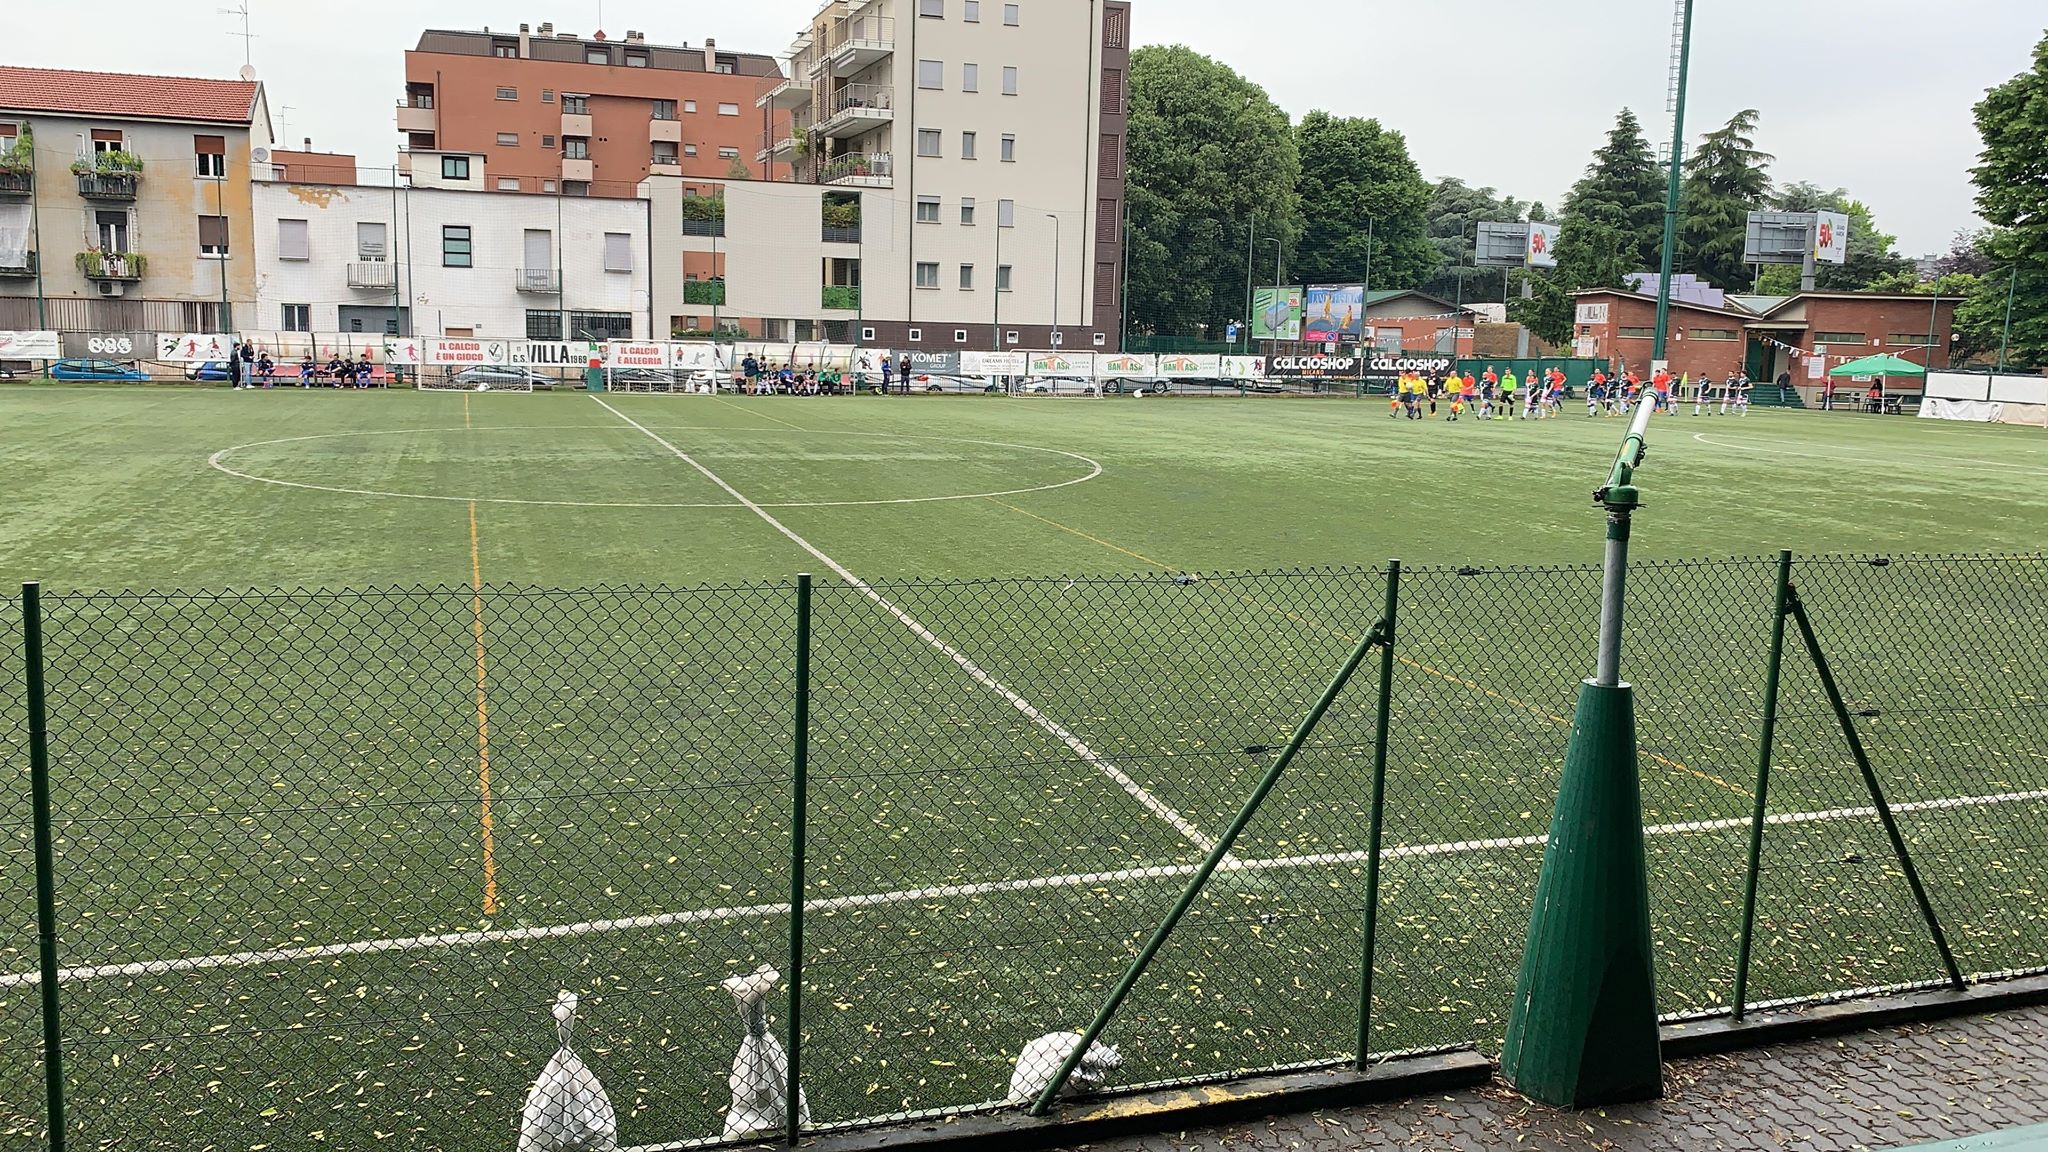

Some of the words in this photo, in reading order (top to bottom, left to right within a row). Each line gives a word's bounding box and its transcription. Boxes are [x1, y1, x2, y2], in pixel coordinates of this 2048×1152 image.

[439, 342, 446, 351] IL
[448, 342, 480, 351] CALCIO
[620, 347, 628, 355] IL
[629, 347, 659, 355] CALCIO
[442, 352, 455, 361] UN
[456, 352, 484, 361] GIOCO
[526, 344, 570, 363] VILLA
[570, 355, 588, 364] 1969
[911, 353, 948, 363] KOMET
[623, 357, 662, 365] ALLEGRIA
